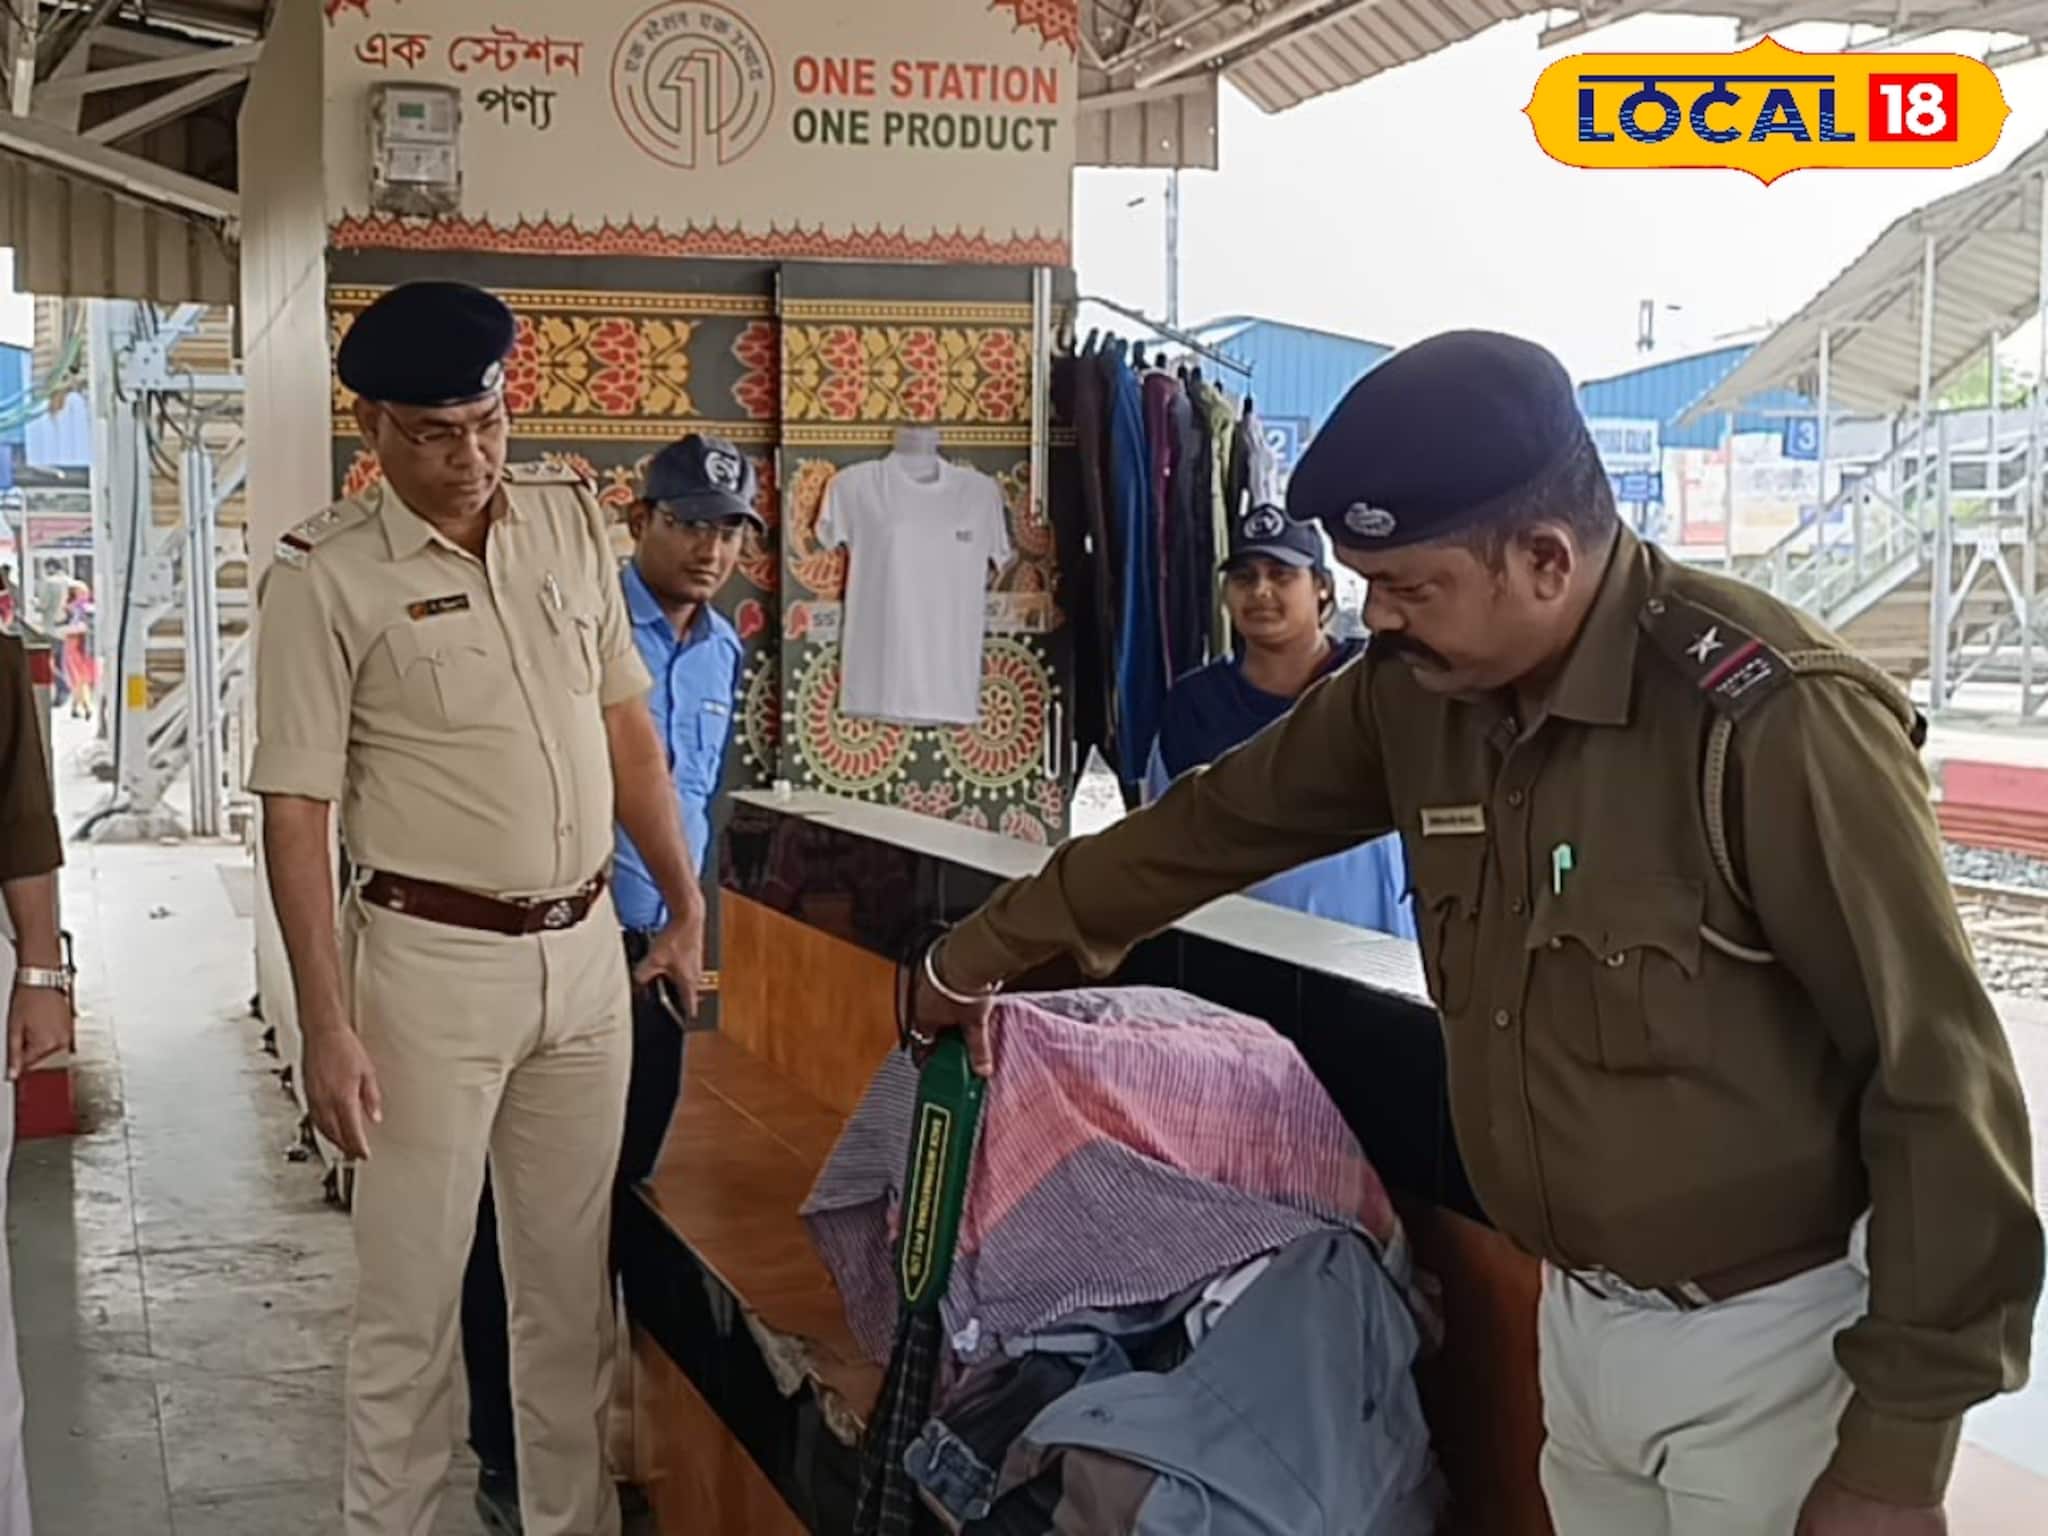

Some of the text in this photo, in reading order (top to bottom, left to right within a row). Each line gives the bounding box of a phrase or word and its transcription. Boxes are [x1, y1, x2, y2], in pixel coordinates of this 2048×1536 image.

[355, 24, 584, 77] এক স্টেশন
[793, 56, 1057, 104] ONE STATION
[477, 84, 557, 130] পণ্য
[793, 108, 1058, 152] ONE PRODUCT
[1798, 421, 1816, 450] 3
